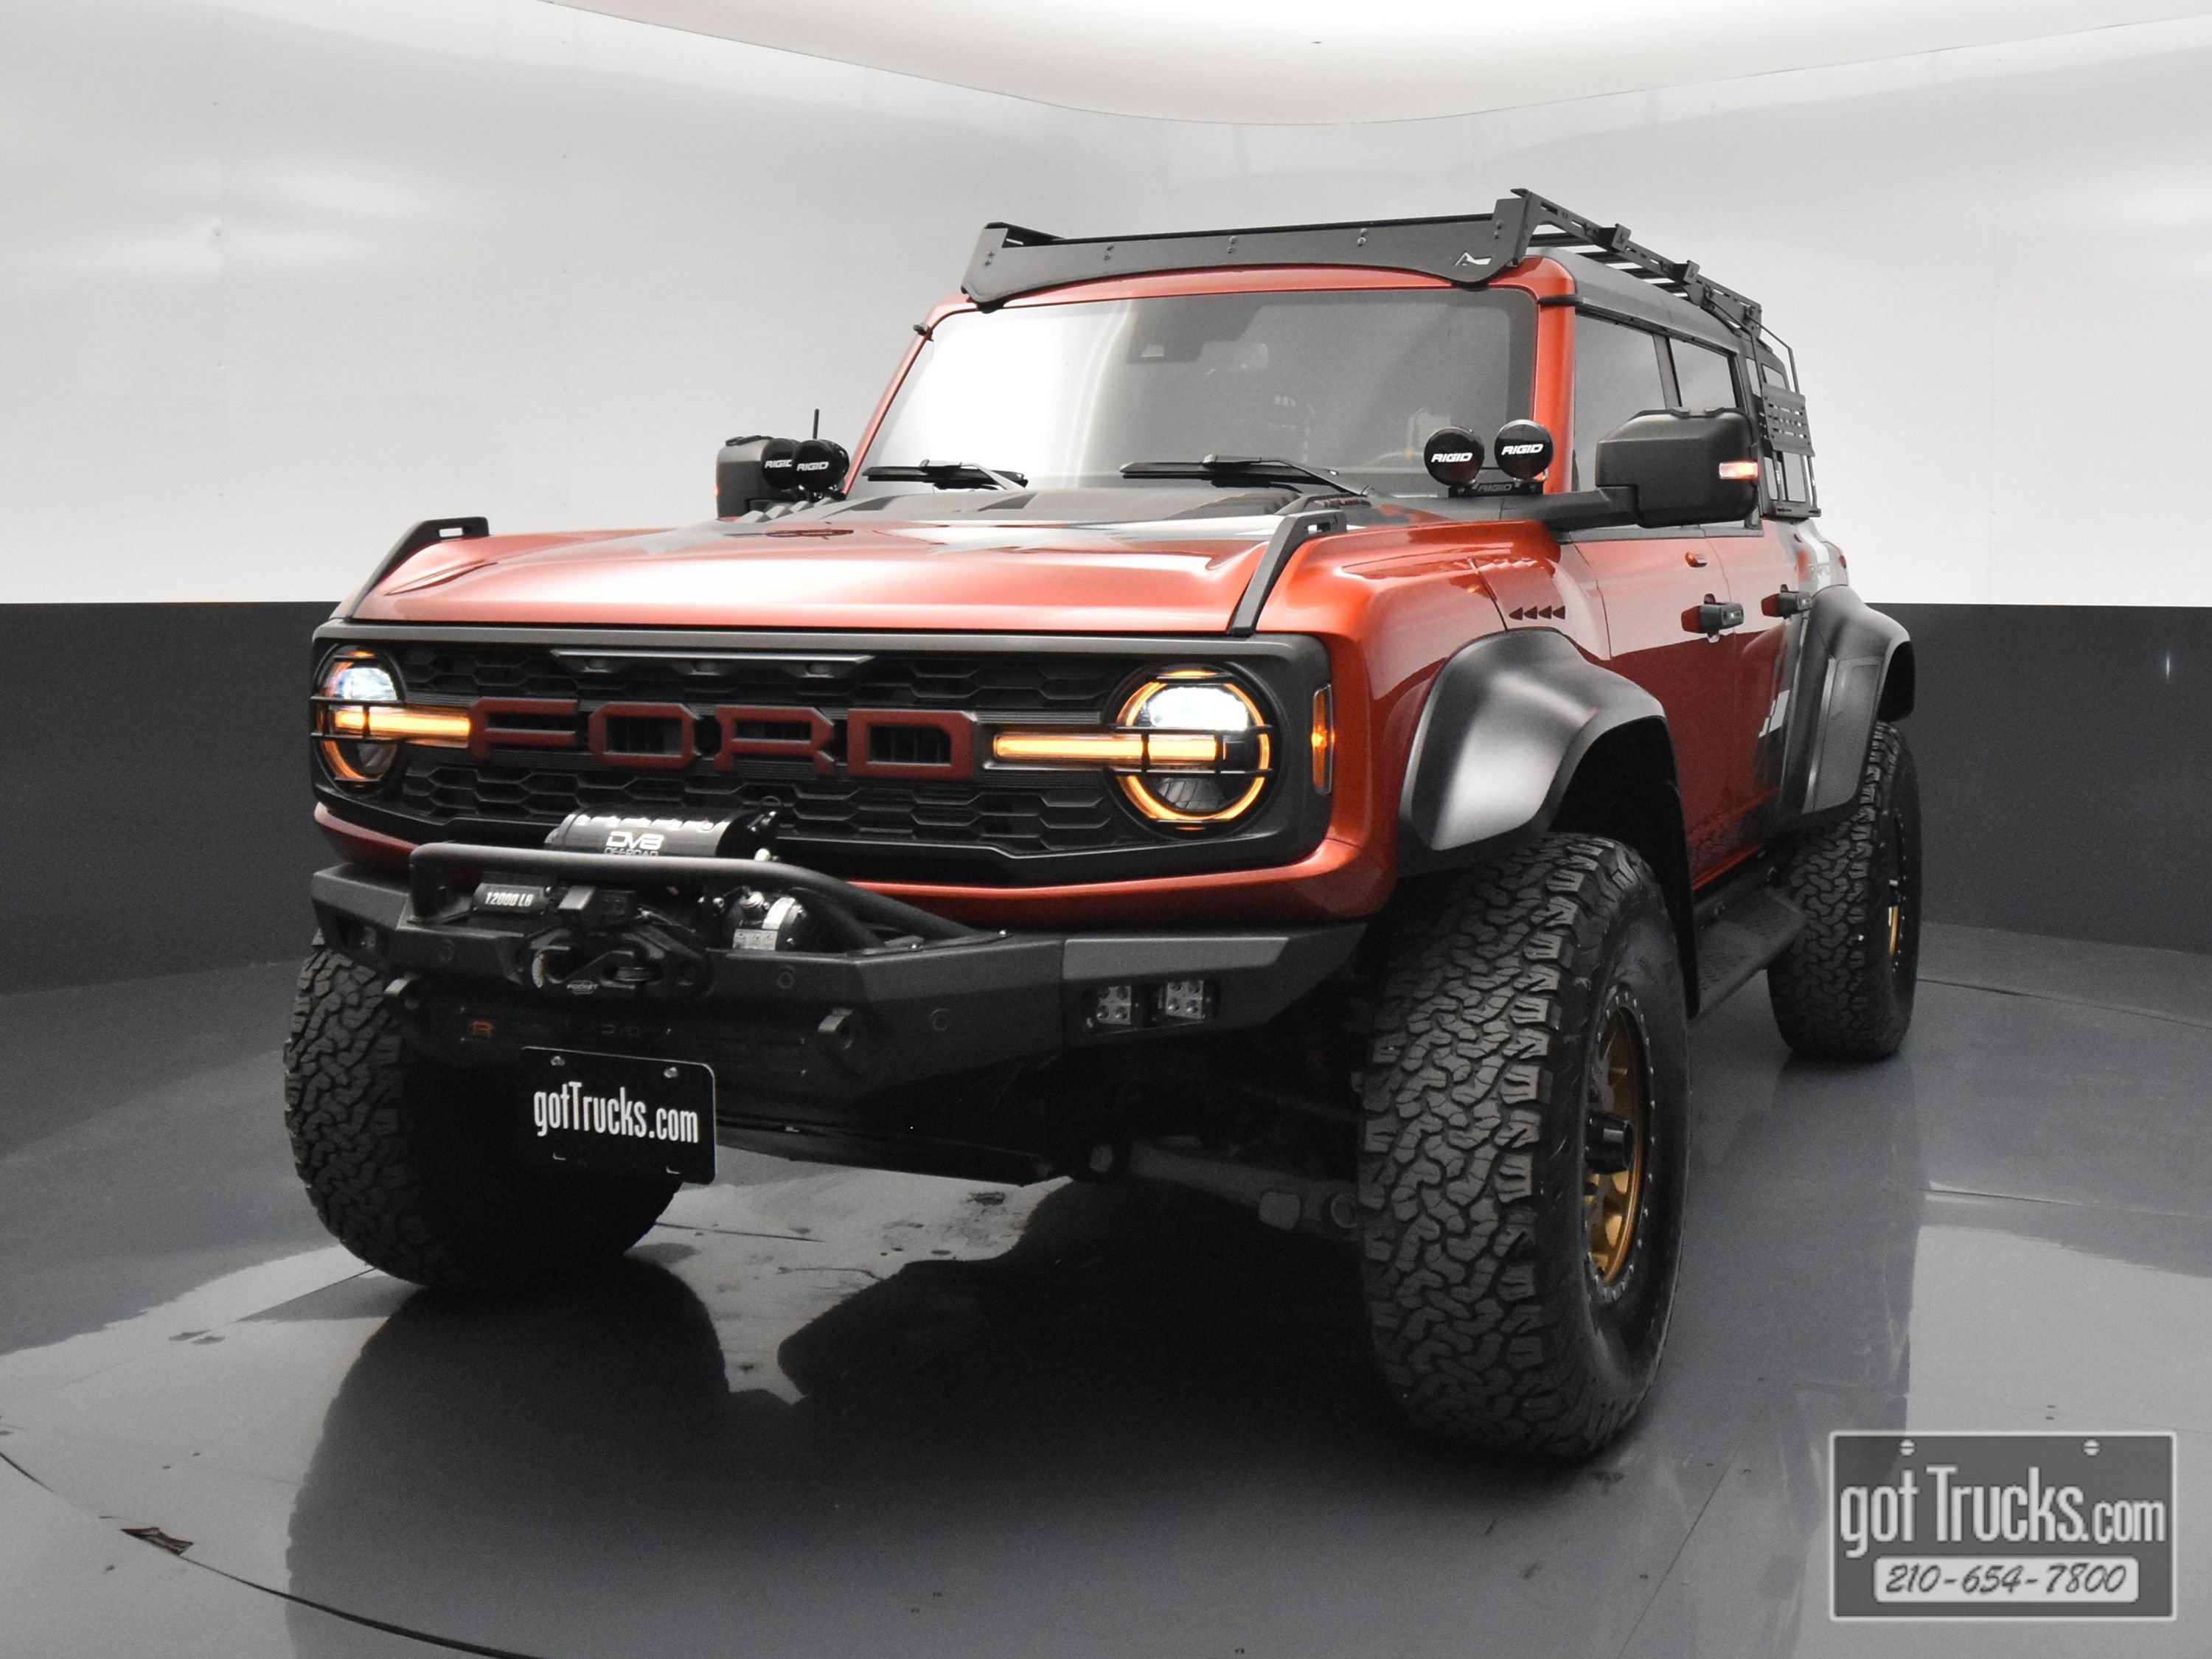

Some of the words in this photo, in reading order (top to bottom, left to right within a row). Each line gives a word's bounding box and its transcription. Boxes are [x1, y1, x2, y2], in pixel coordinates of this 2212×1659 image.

[1501, 444, 1543, 455] RIGID
[1430, 452, 1473, 463] RIGID
[796, 461, 829, 471] RIGID
[1478, 483, 1512, 491] RIGID
[469, 697, 979, 779] FORD
[605, 831, 664, 849] DV8
[484, 891, 518, 907] 12000
[518, 894, 534, 907] LB
[533, 1081, 698, 1144] gotTrucks.com
